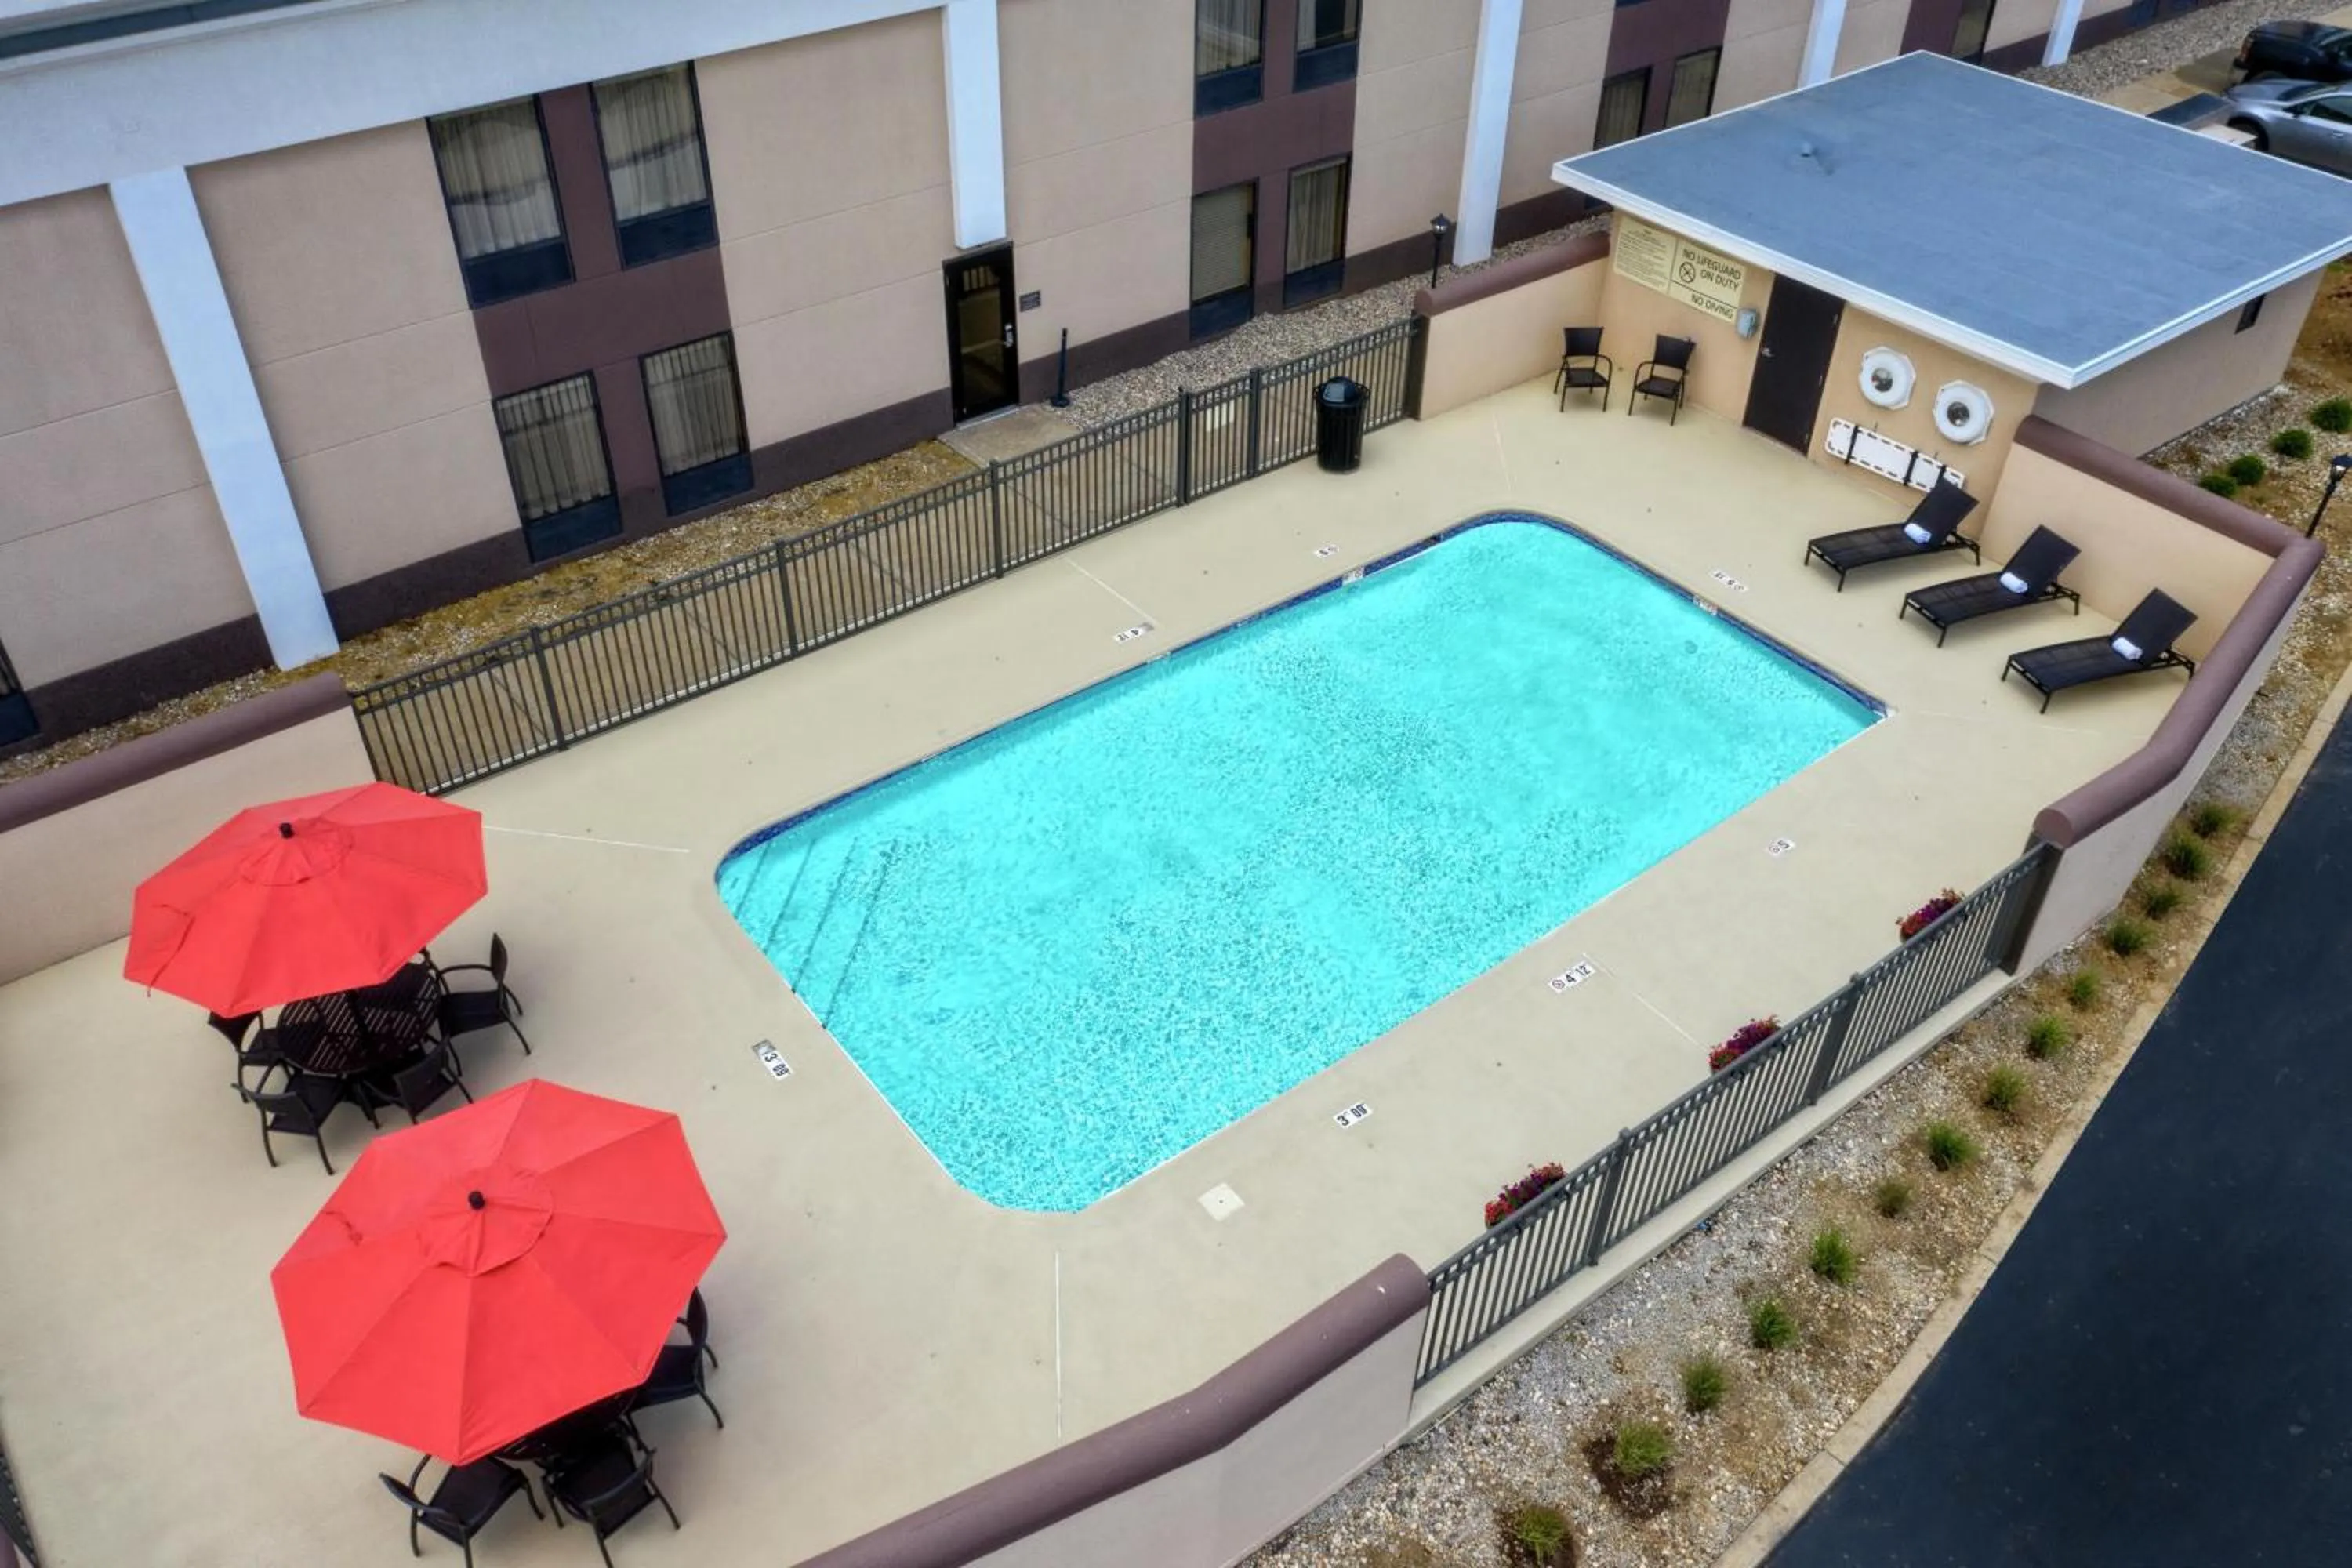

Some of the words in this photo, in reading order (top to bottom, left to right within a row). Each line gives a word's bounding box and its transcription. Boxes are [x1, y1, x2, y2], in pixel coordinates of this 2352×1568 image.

[1683, 249, 1695, 261] NO
[1697, 255, 1741, 279] LIFEGUARD
[1700, 269, 1714, 282] ON
[1715, 275, 1740, 292] DUTY
[1692, 294, 1704, 306] NO
[1705, 300, 1733, 318] DIVING
